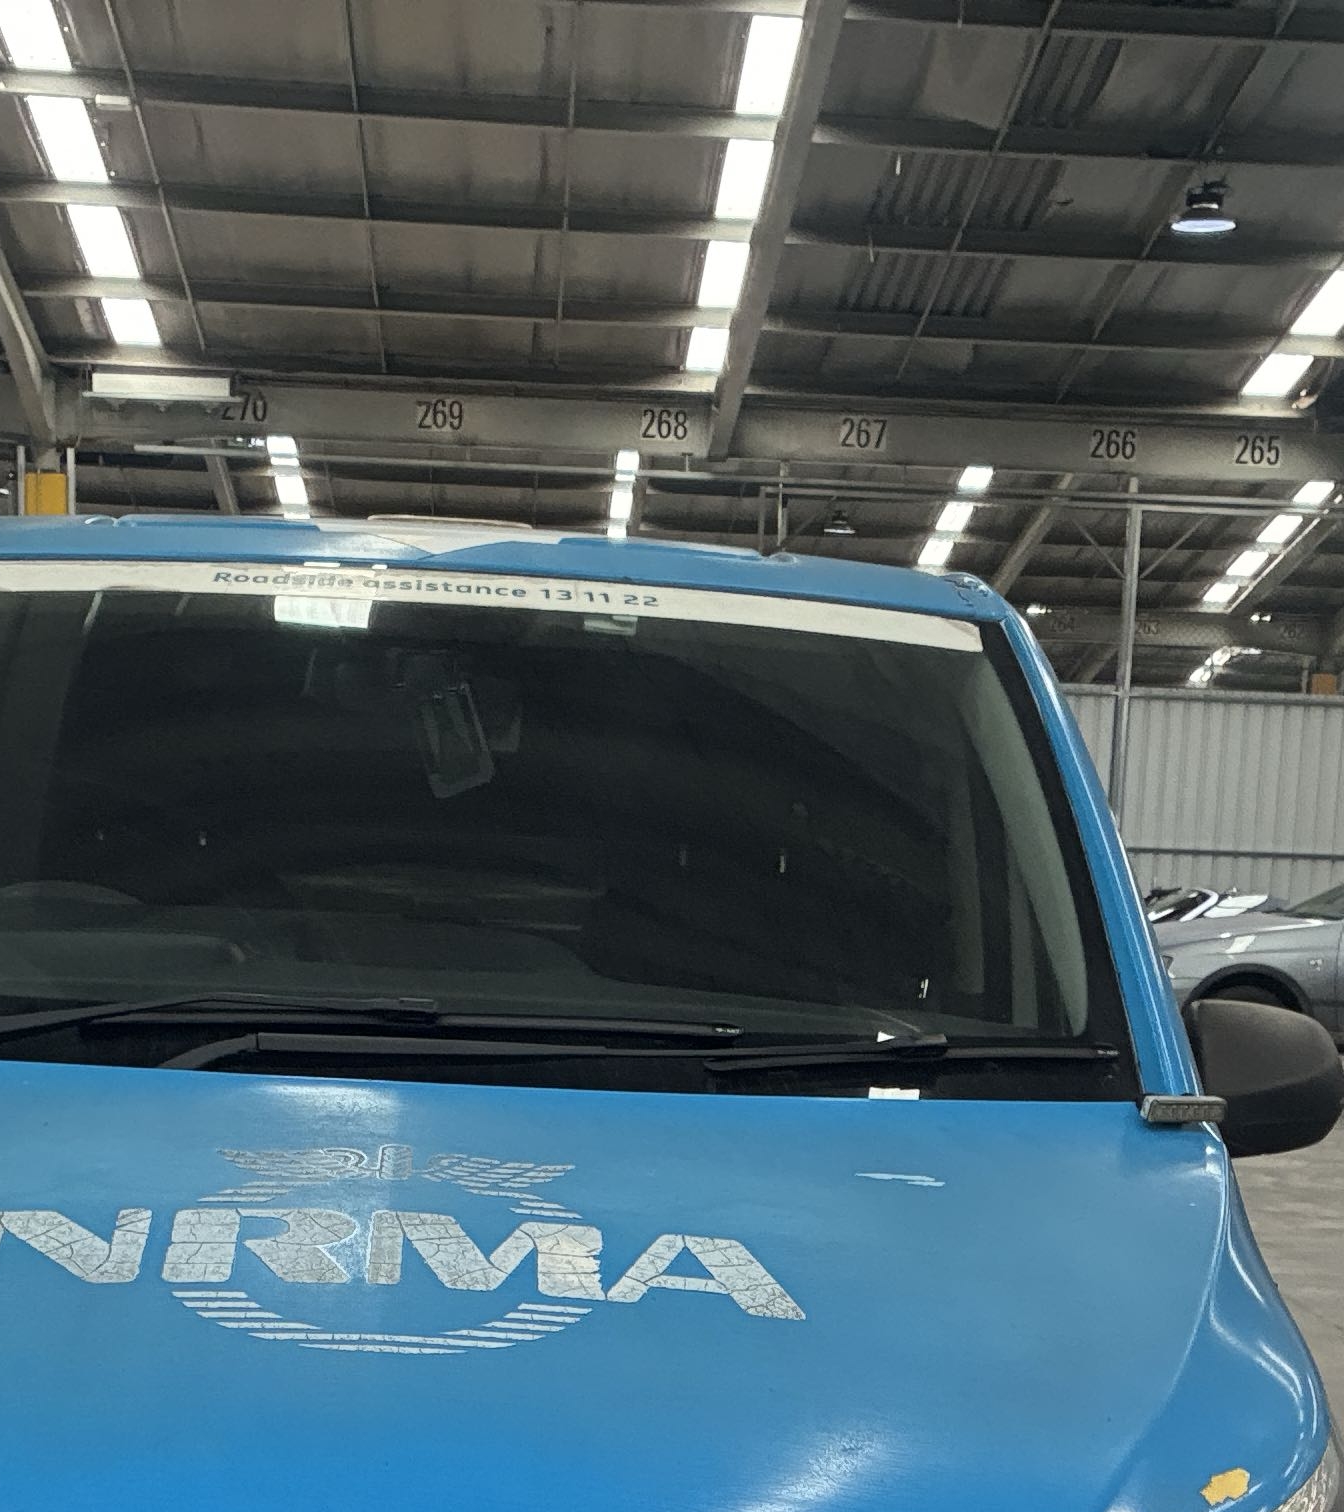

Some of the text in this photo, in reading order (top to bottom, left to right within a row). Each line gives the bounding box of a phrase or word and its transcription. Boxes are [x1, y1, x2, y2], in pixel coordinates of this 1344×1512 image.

[418, 401, 464, 431] 269
[642, 409, 688, 440] 268
[841, 418, 887, 449] 267
[1091, 430, 1136, 460] 266
[1235, 435, 1280, 465] 265
[213, 572, 659, 607] Roadside assistance 13 11 22
